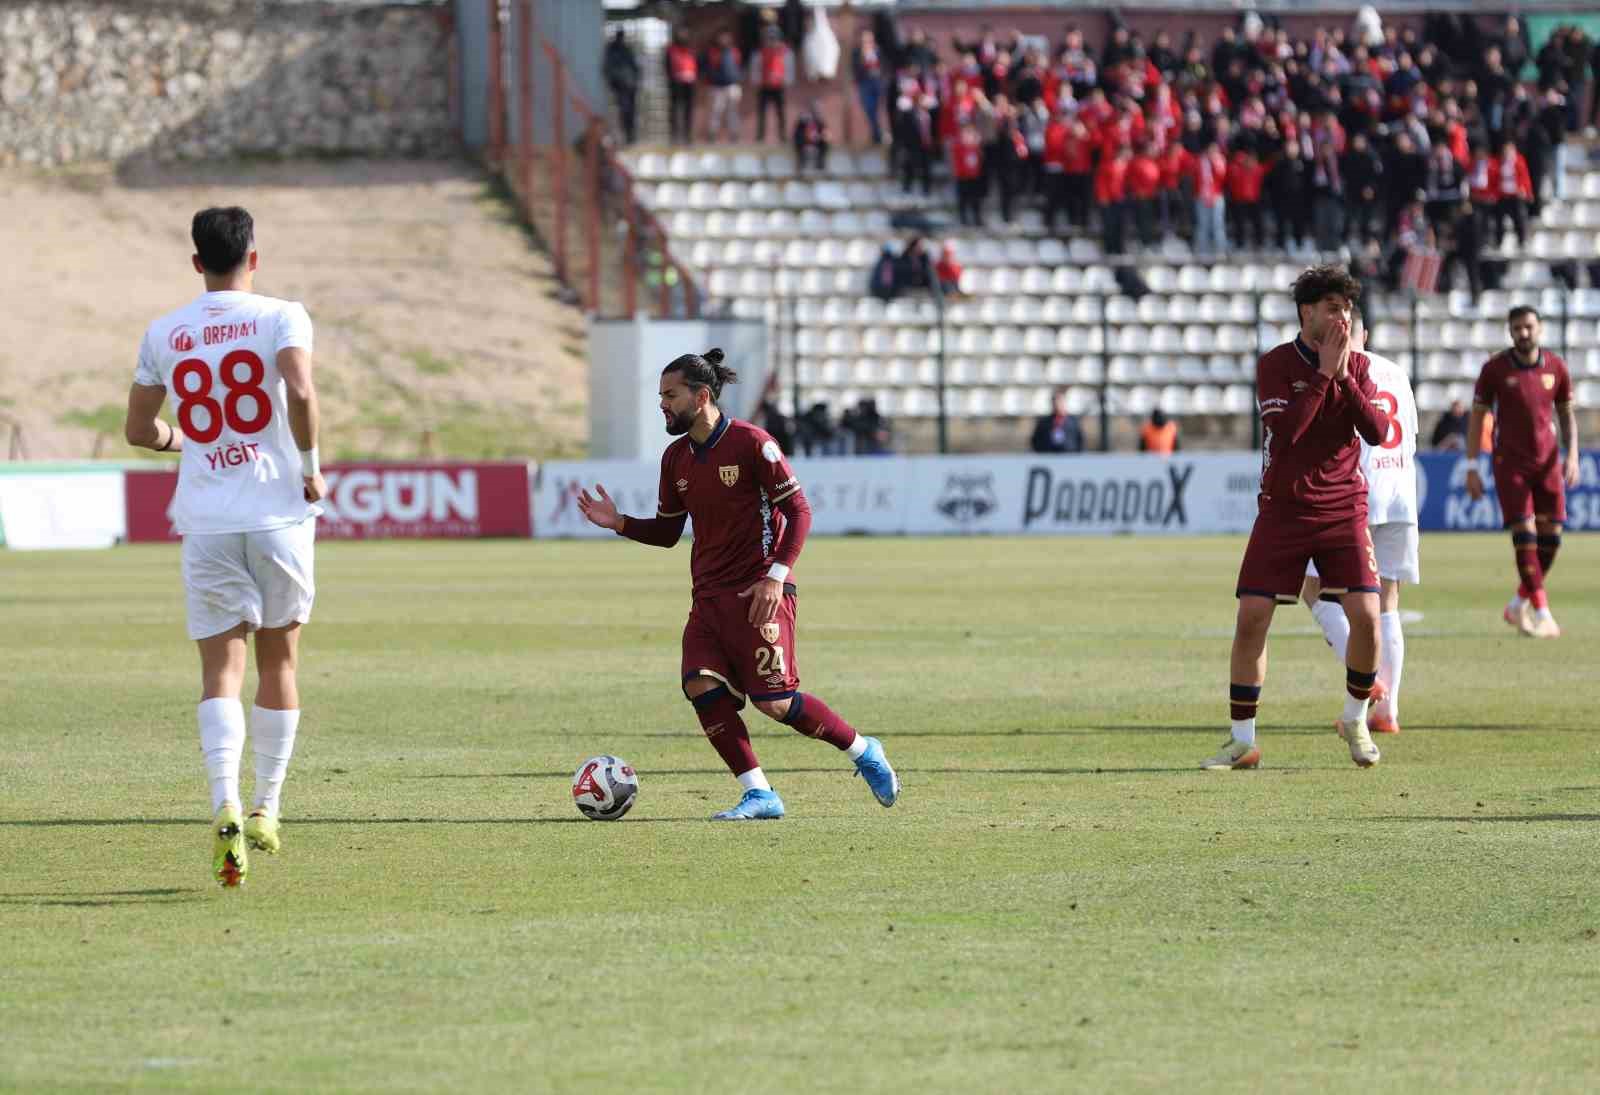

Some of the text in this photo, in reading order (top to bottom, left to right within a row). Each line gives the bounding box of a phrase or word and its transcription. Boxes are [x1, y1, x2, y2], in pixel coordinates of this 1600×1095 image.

[172, 349, 273, 444] 88
[205, 441, 259, 471] YİĞİT
[755, 646, 787, 676] 24
